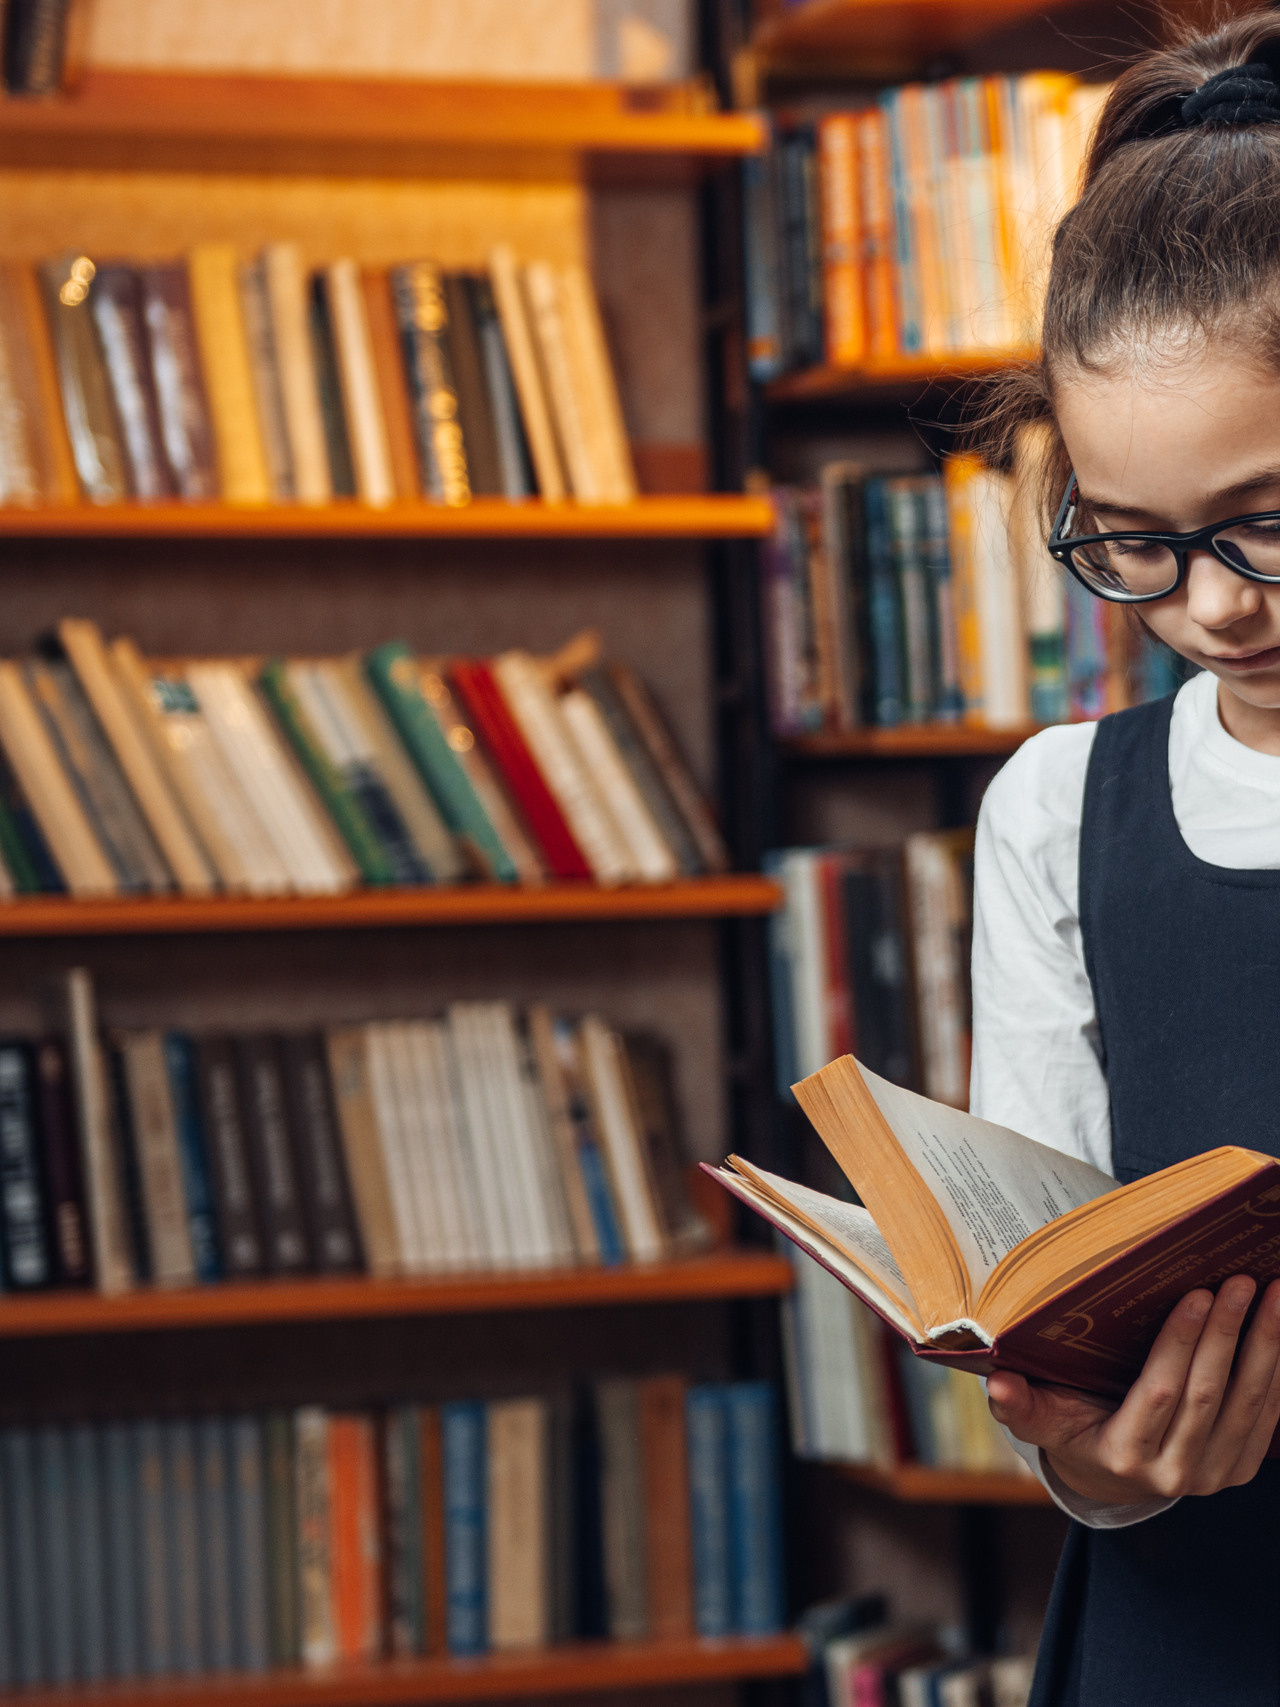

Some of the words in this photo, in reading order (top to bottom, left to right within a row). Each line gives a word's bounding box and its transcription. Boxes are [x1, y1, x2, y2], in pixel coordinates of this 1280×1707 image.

[1111, 1299, 1136, 1317] ДЛЯ
[1134, 1265, 1194, 1299] УЧЕНИКА
[1206, 1223, 1263, 1257] УЧИТЕЛЯ
[1154, 1254, 1198, 1279] КНИГА
